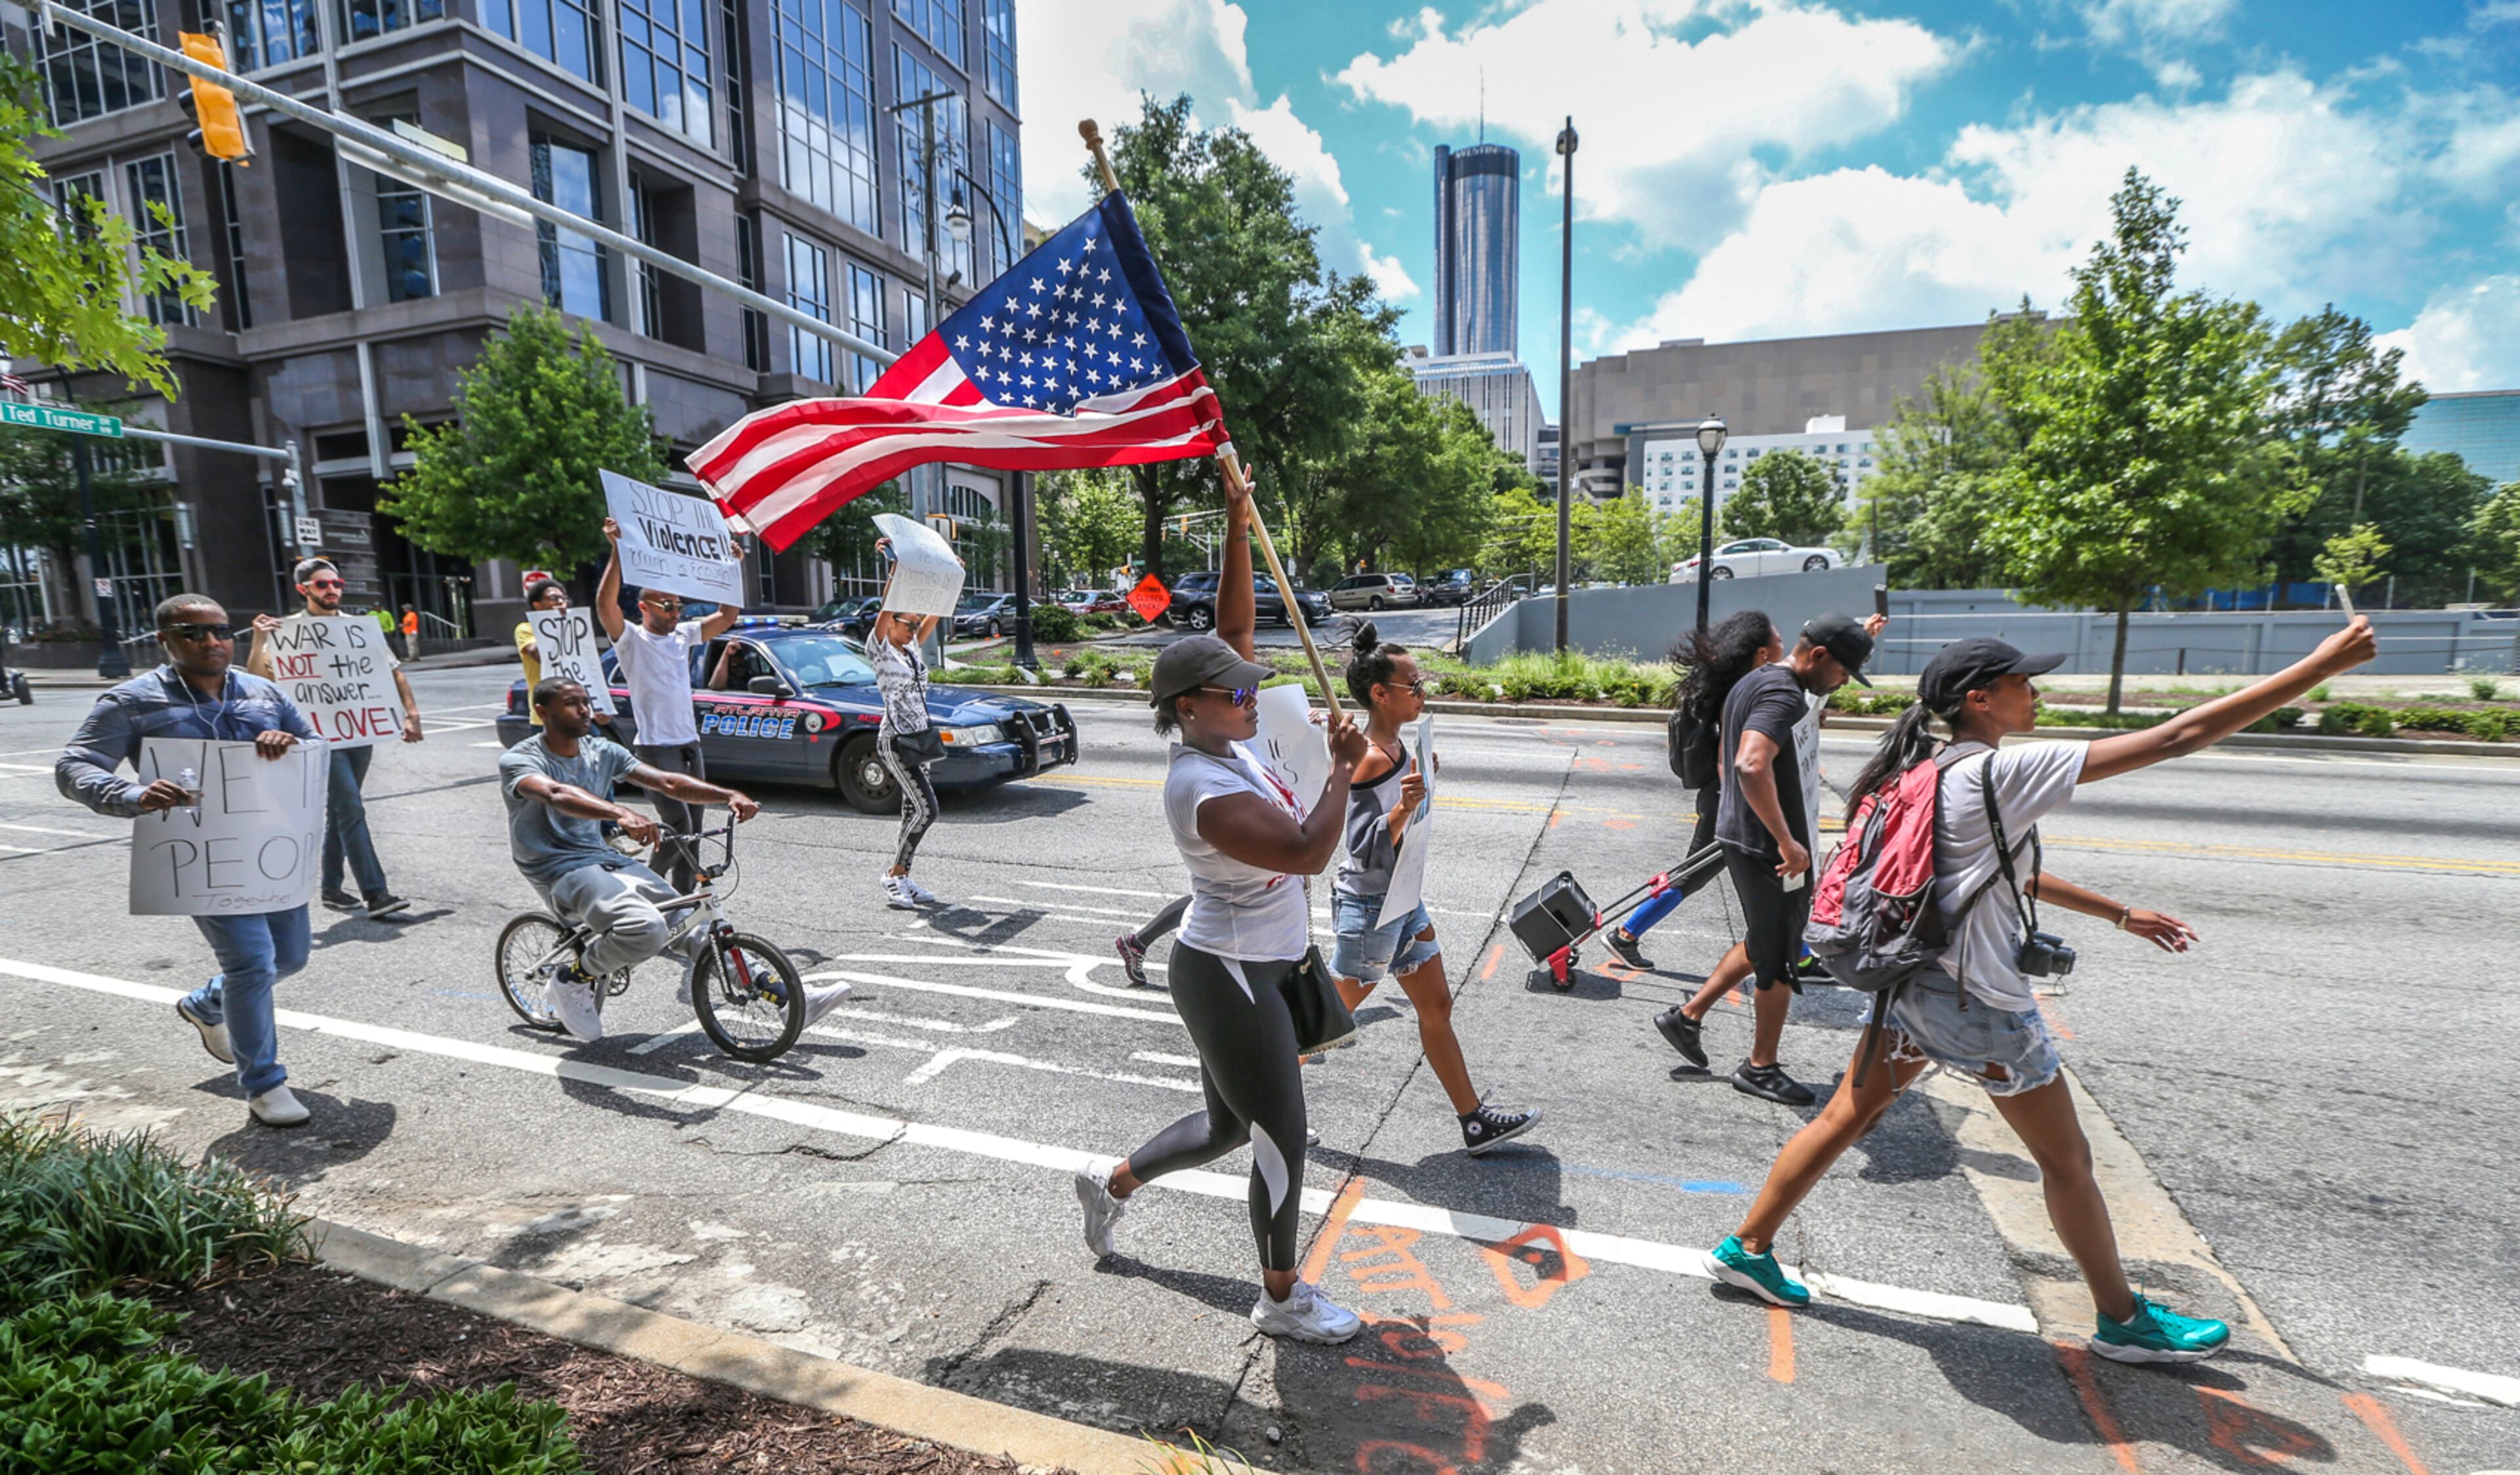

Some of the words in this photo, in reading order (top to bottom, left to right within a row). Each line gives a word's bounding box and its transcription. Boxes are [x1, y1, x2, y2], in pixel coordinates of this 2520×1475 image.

[5, 404, 37, 423] Ted
[42, 409, 95, 430] Turner
[629, 482, 683, 524] STOP
[298, 518, 316, 527] ONE
[270, 623, 336, 650] WAR
[345, 625, 367, 649] IS
[538, 616, 588, 661] STOP
[276, 654, 318, 676] NOT
[329, 654, 373, 678] the
[713, 703, 801, 718] ATLANTA
[700, 714, 796, 740] POLICE
[149, 741, 269, 828] WE
[192, 890, 293, 910] Together
